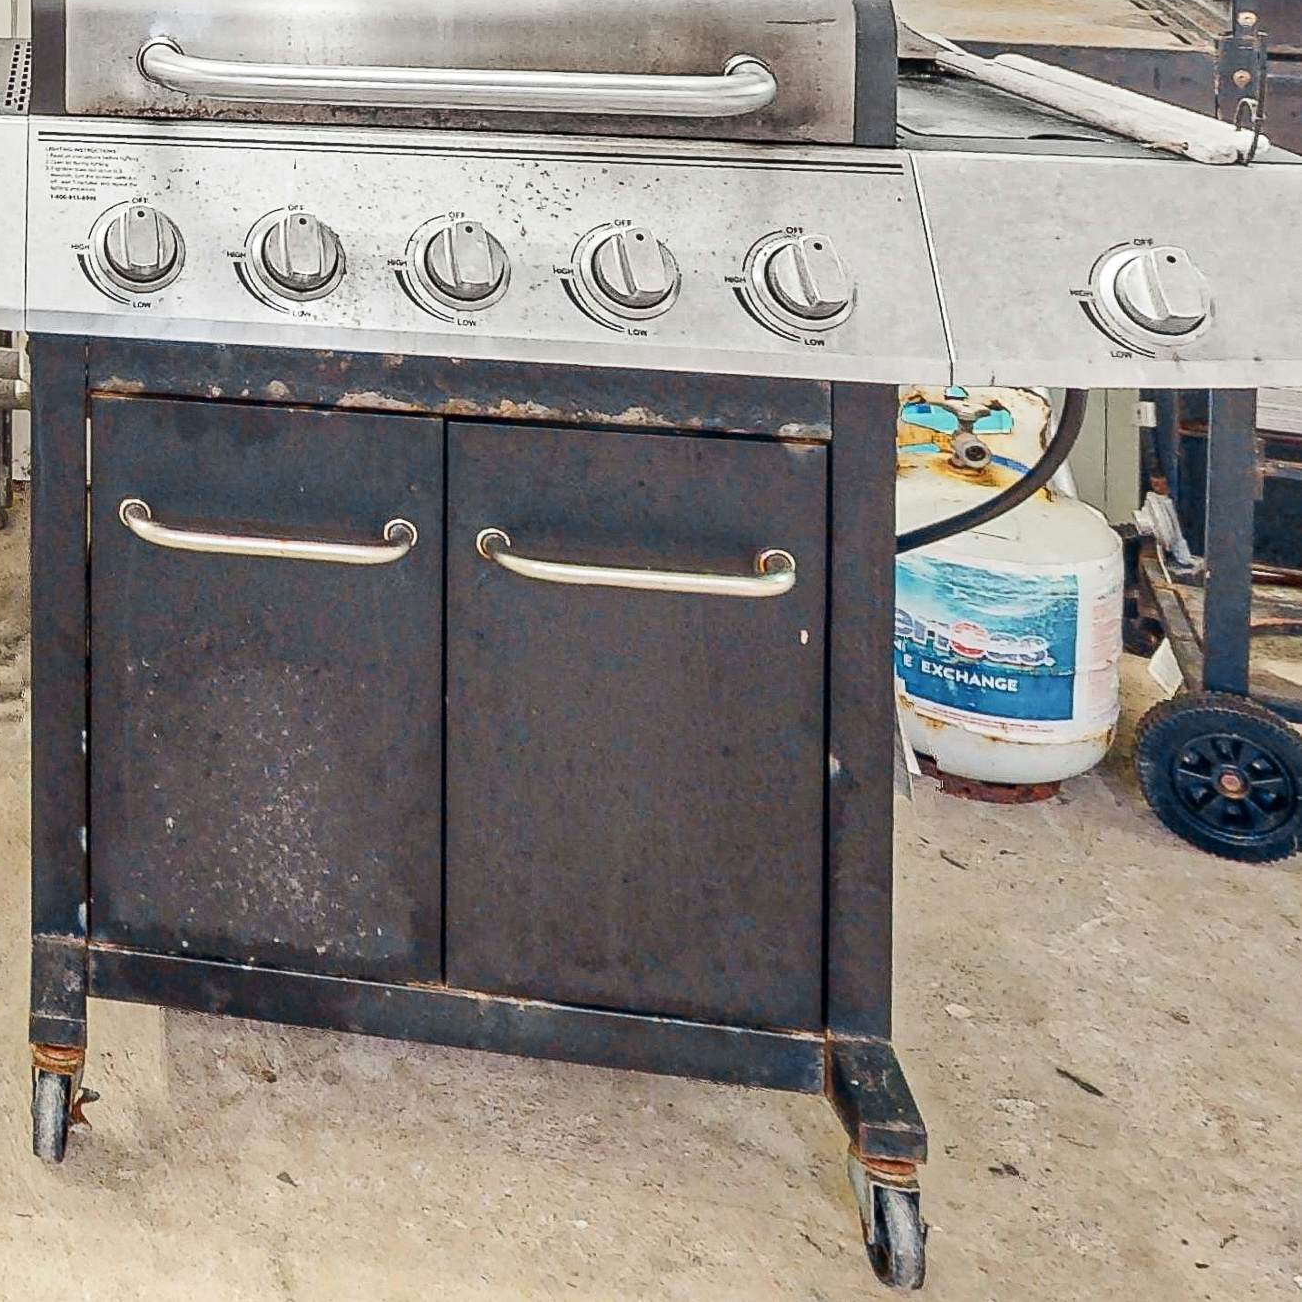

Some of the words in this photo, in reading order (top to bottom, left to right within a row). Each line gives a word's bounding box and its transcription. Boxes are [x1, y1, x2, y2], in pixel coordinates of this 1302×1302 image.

[553, 266, 574, 275] HIGH
[724, 275, 746, 283] HIGH
[1069, 288, 1093, 297] HIGH
[627, 328, 648, 336] LOW
[804, 338, 825, 347] LOW
[1110, 350, 1132, 359] LOW
[921, 659, 1020, 692] EXCHANGE
